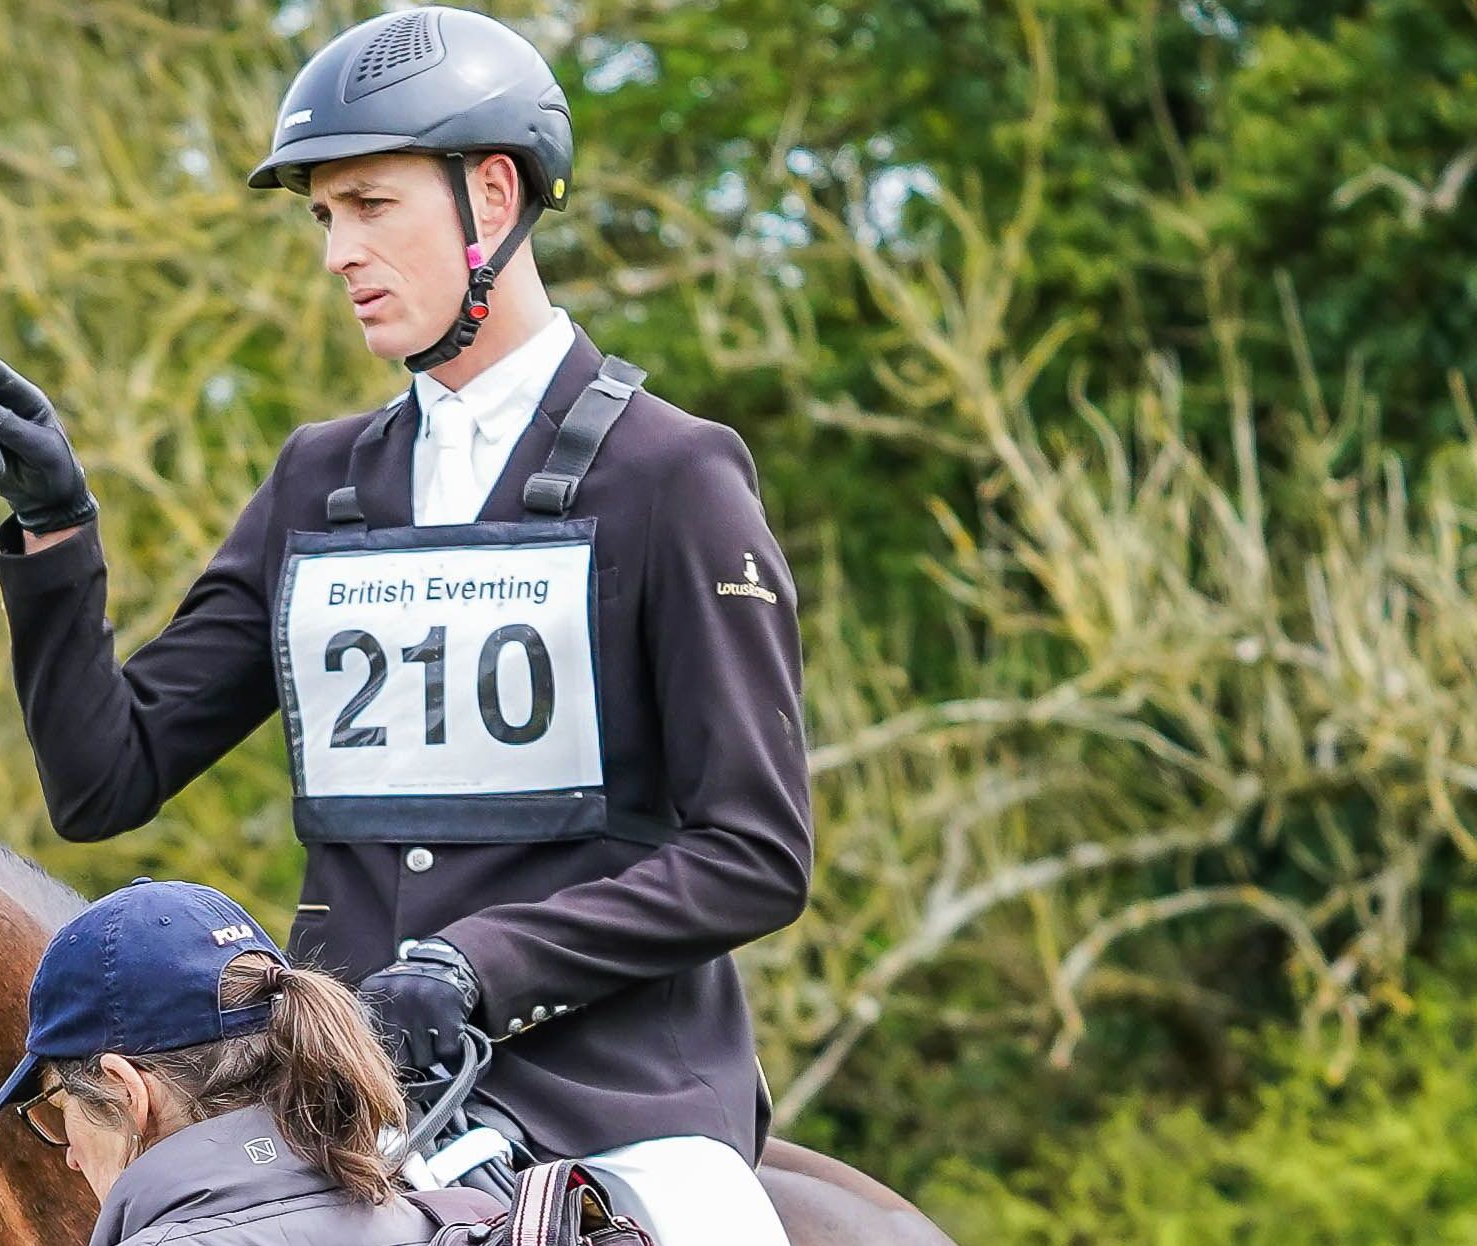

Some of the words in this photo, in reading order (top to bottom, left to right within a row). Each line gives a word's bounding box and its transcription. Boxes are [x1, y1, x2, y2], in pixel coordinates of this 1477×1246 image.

[328, 579, 415, 606] British
[426, 576, 549, 605] Eventing
[324, 623, 556, 748] 210
[212, 925, 253, 946] POLO
